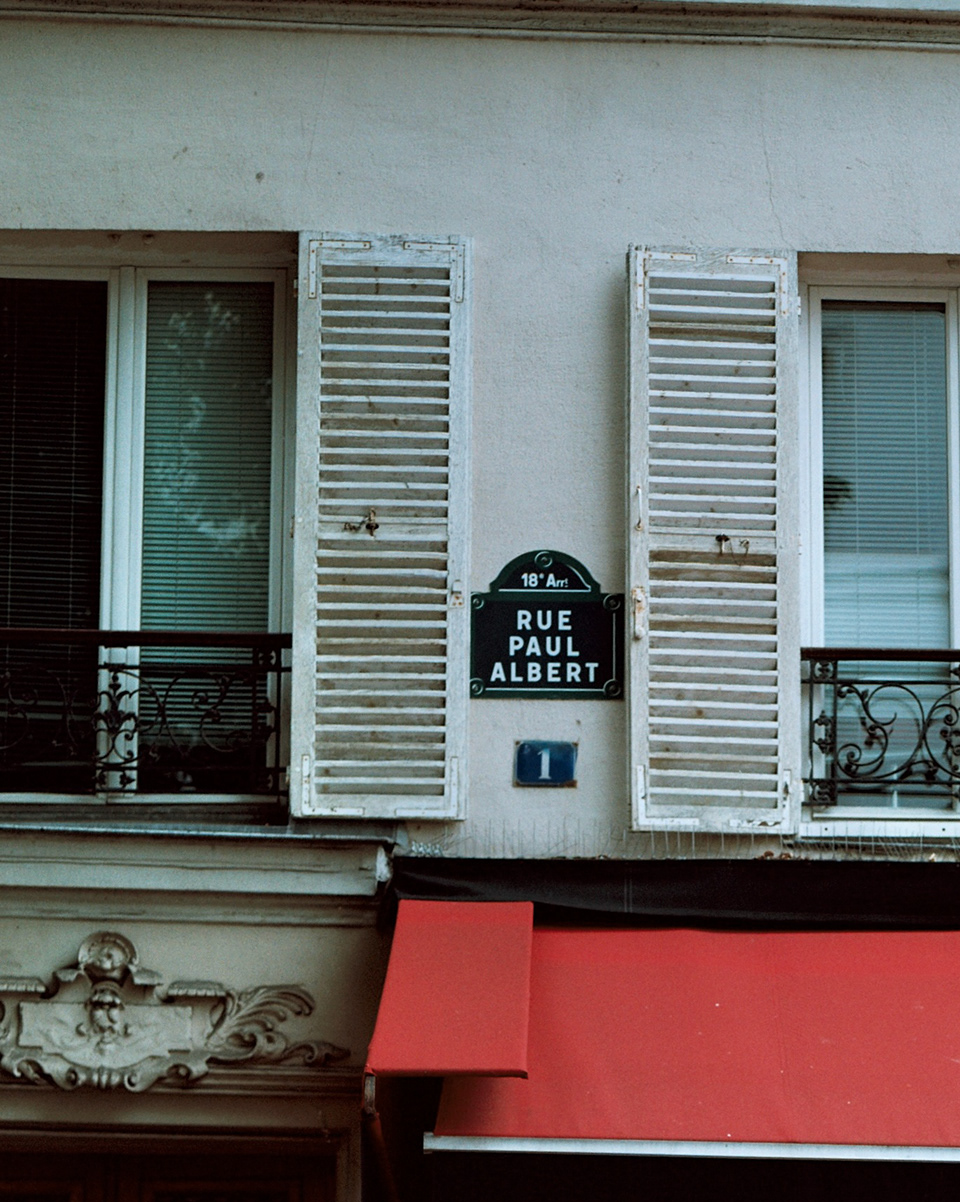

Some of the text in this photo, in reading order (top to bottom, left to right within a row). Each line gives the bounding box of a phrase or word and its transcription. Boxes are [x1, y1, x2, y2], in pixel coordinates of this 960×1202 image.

[517, 610, 572, 631] RUE
[509, 636, 580, 657] PAUL
[490, 662, 599, 683] ALBERT
[537, 748, 552, 780] 1
